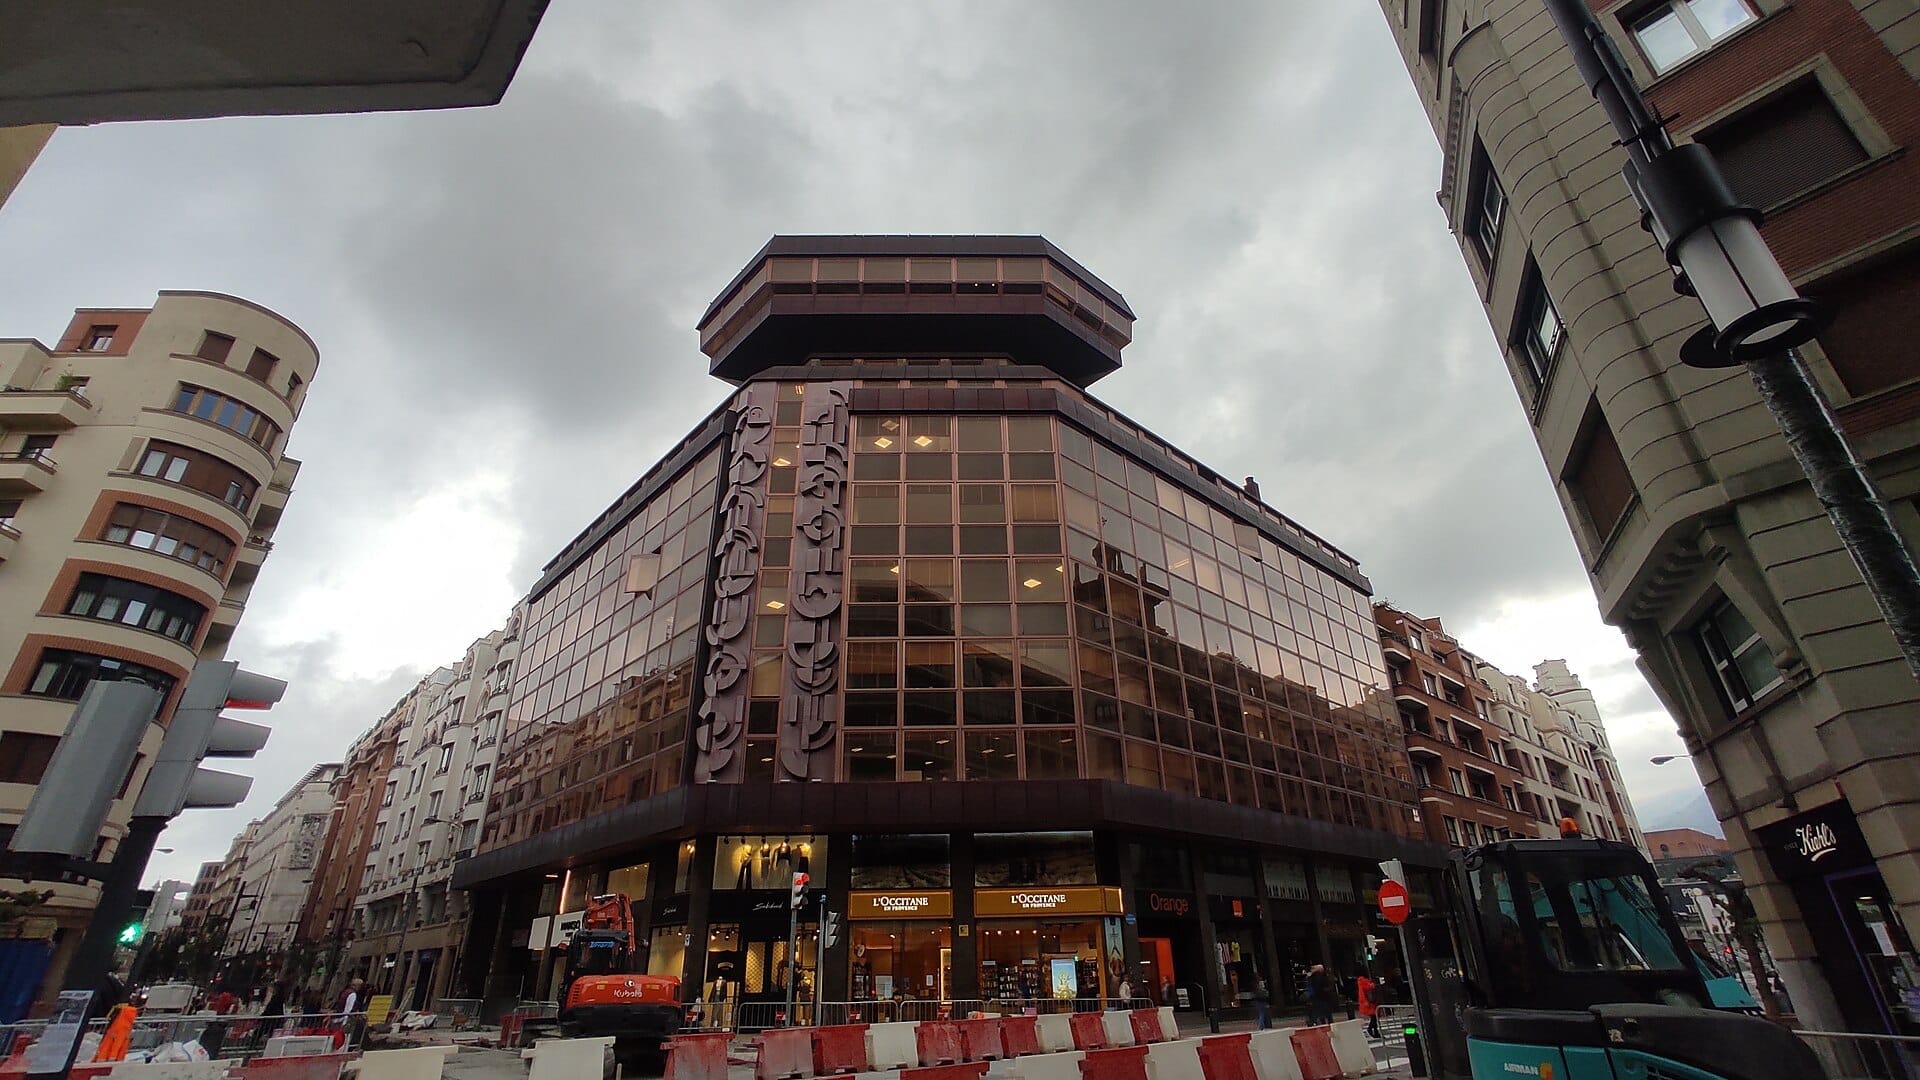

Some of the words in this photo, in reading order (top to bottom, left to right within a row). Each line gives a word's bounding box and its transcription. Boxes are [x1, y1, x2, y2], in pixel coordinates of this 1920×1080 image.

[1795, 822, 1837, 856] Kiehl's
[873, 896, 929, 907] L'OCCITANE
[1010, 893, 1067, 904] L'OCCITANE
[1150, 893, 1189, 916] Orange
[613, 989, 643, 998] Kubota
[1503, 1062, 1539, 1076] AIRMAN
